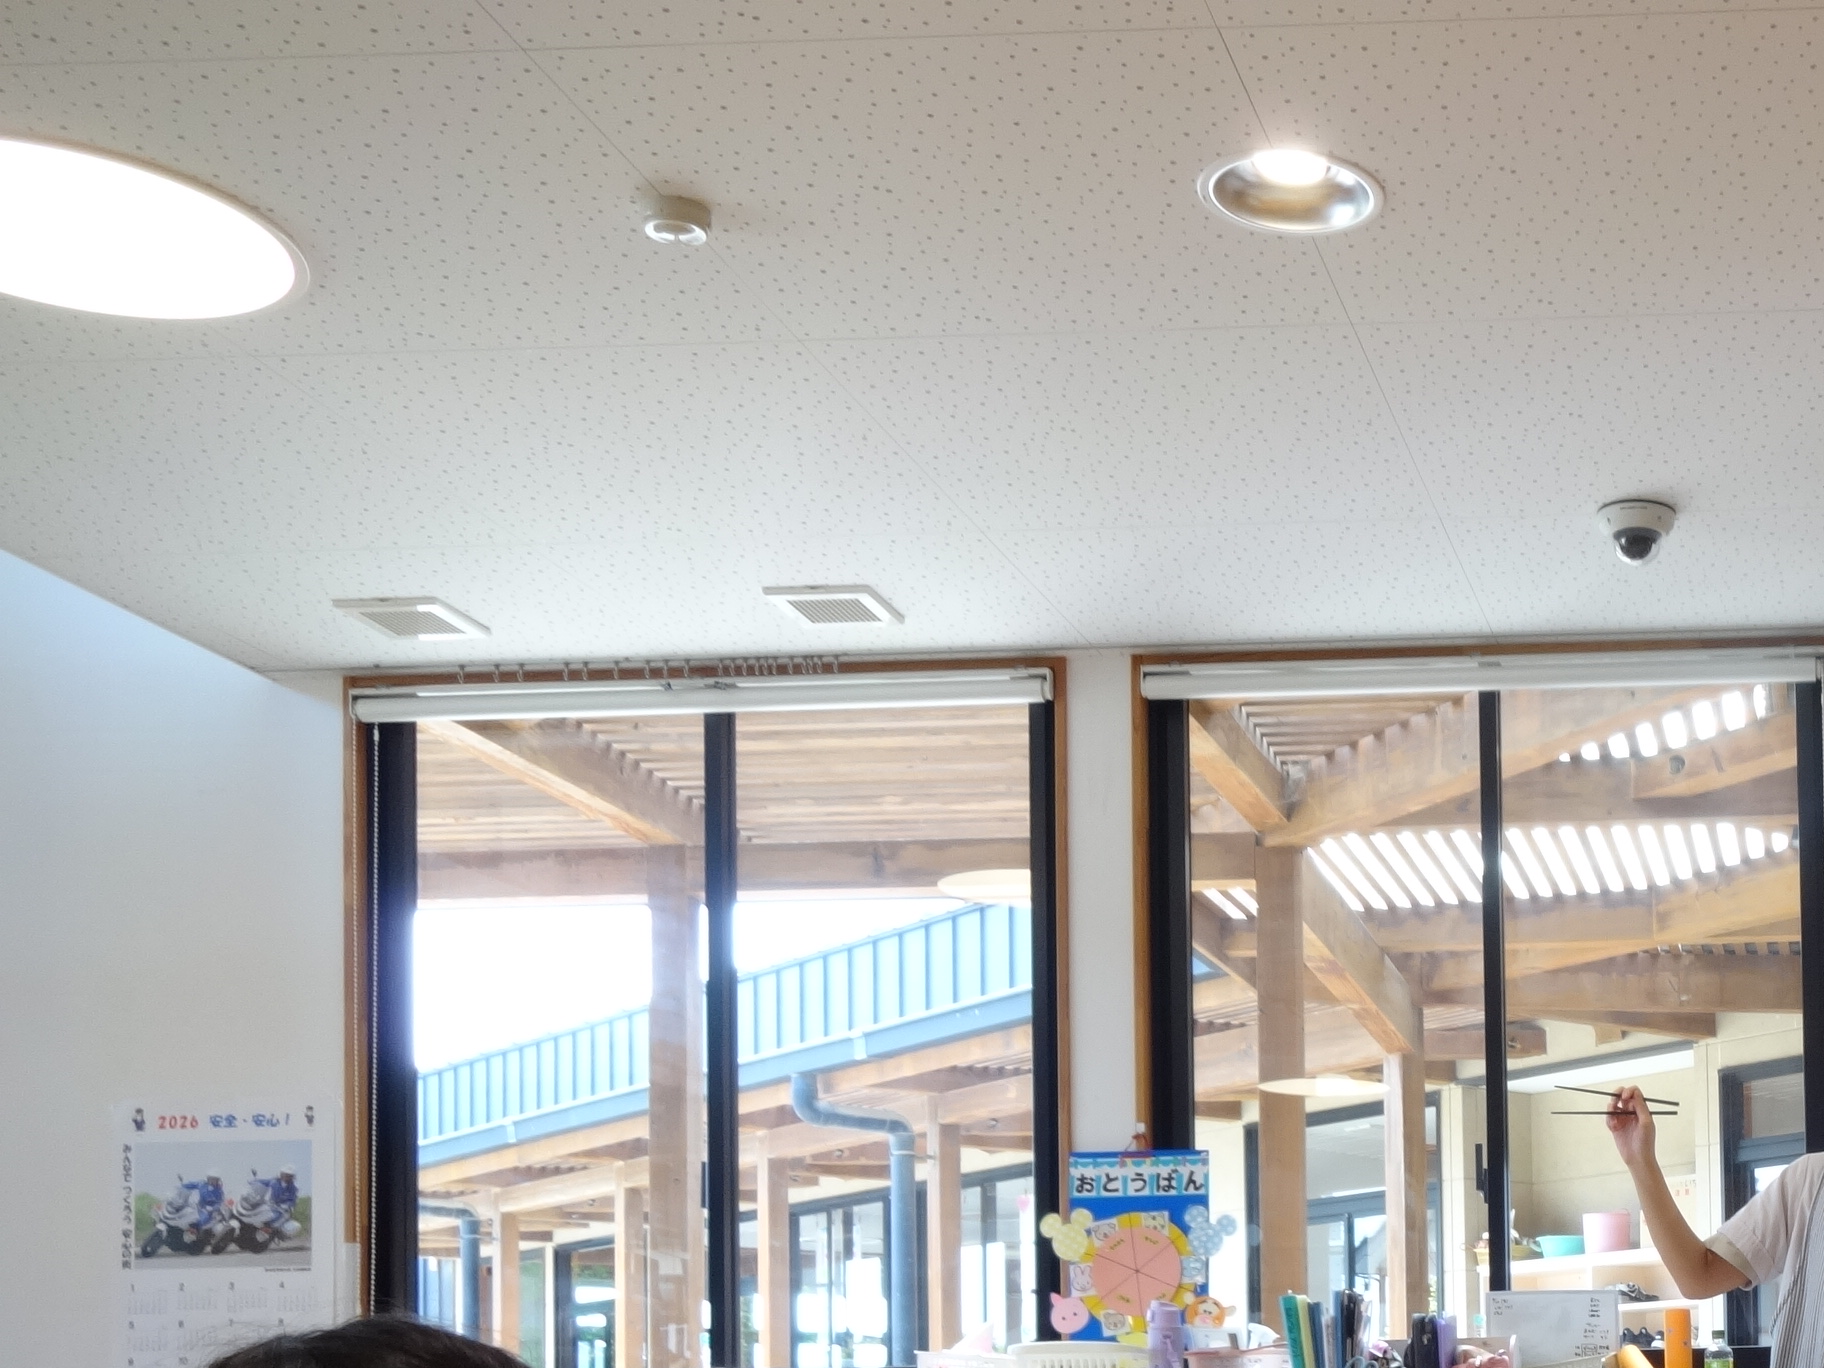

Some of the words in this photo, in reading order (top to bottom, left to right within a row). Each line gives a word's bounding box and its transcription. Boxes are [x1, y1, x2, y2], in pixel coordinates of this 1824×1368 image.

[157, 1114, 199, 1130] 2026
[1075, 1168, 1204, 1193] おとうばん
